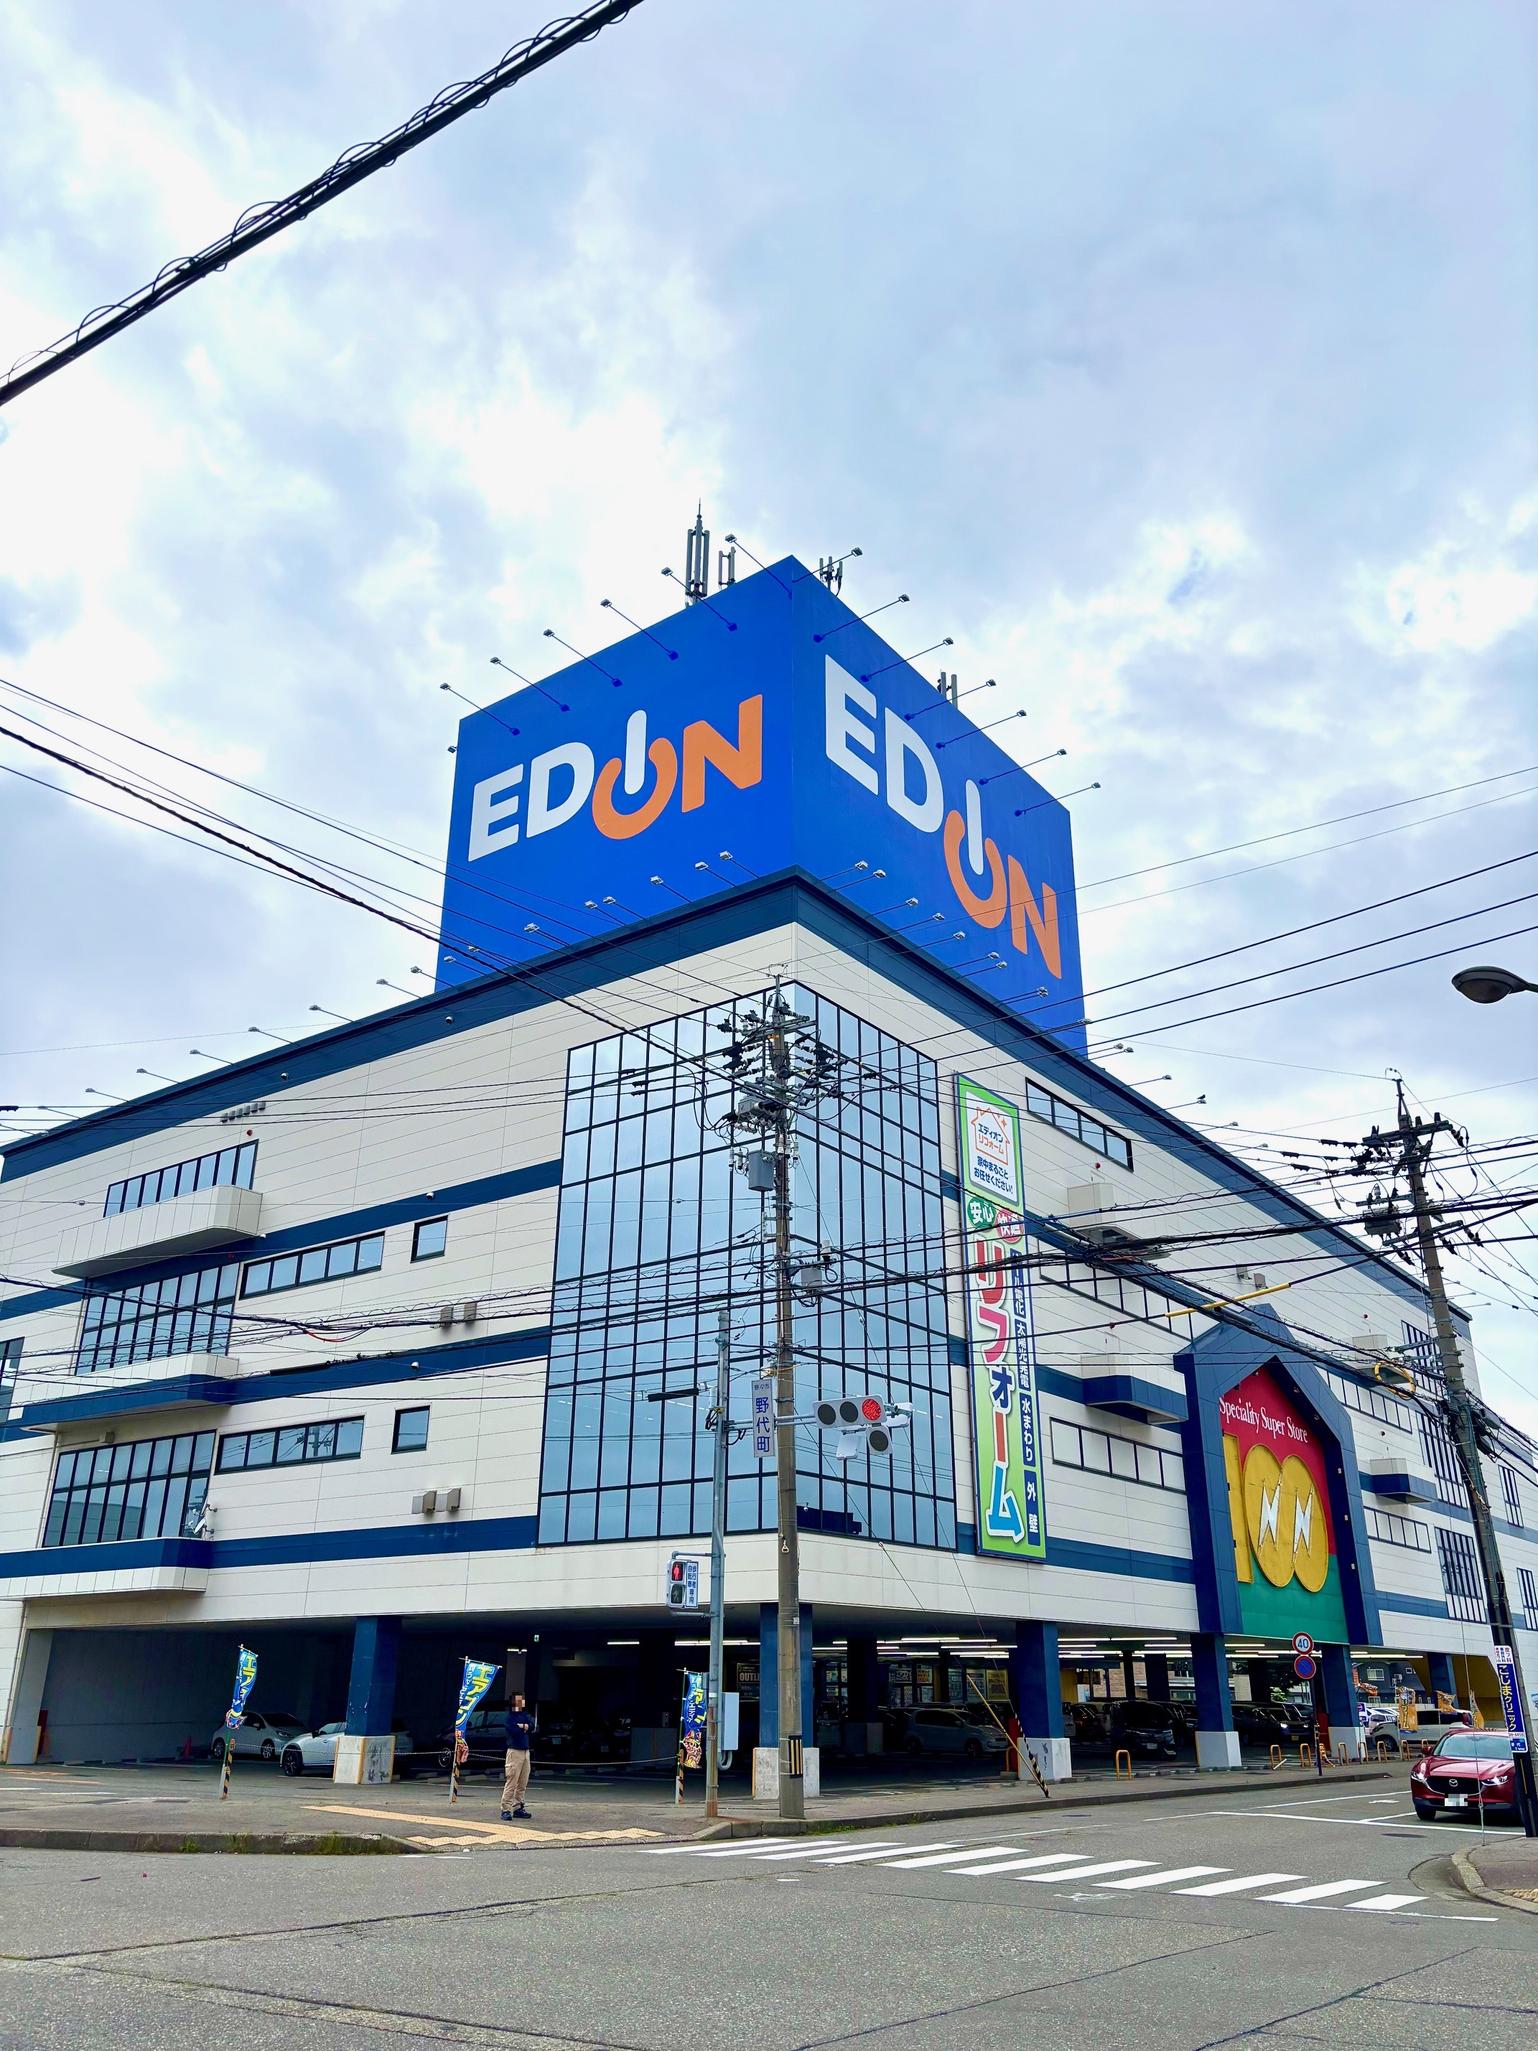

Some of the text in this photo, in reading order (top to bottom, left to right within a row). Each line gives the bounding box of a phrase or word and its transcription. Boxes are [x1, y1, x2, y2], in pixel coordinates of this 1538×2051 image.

[467, 694, 763, 862] EDION
[825, 654, 1062, 979] EDION
[978, 1123, 1004, 1143] エディオン
[978, 1133, 1004, 1155] リフォーム
[977, 1155, 1009, 1180] 家中まるごと
[969, 1201, 994, 1224] 安心
[976, 1236, 1024, 1540] リフォーム
[755, 1396, 771, 1453] 野代町
[1021, 1397, 1034, 1462] 水まわり
[1219, 1396, 1308, 1443] Speciality Super Store
[1297, 1638, 1309, 1650] 40
[455, 1663, 496, 1727] エアコン
[1498, 1664, 1517, 1731] こじまクリニック
